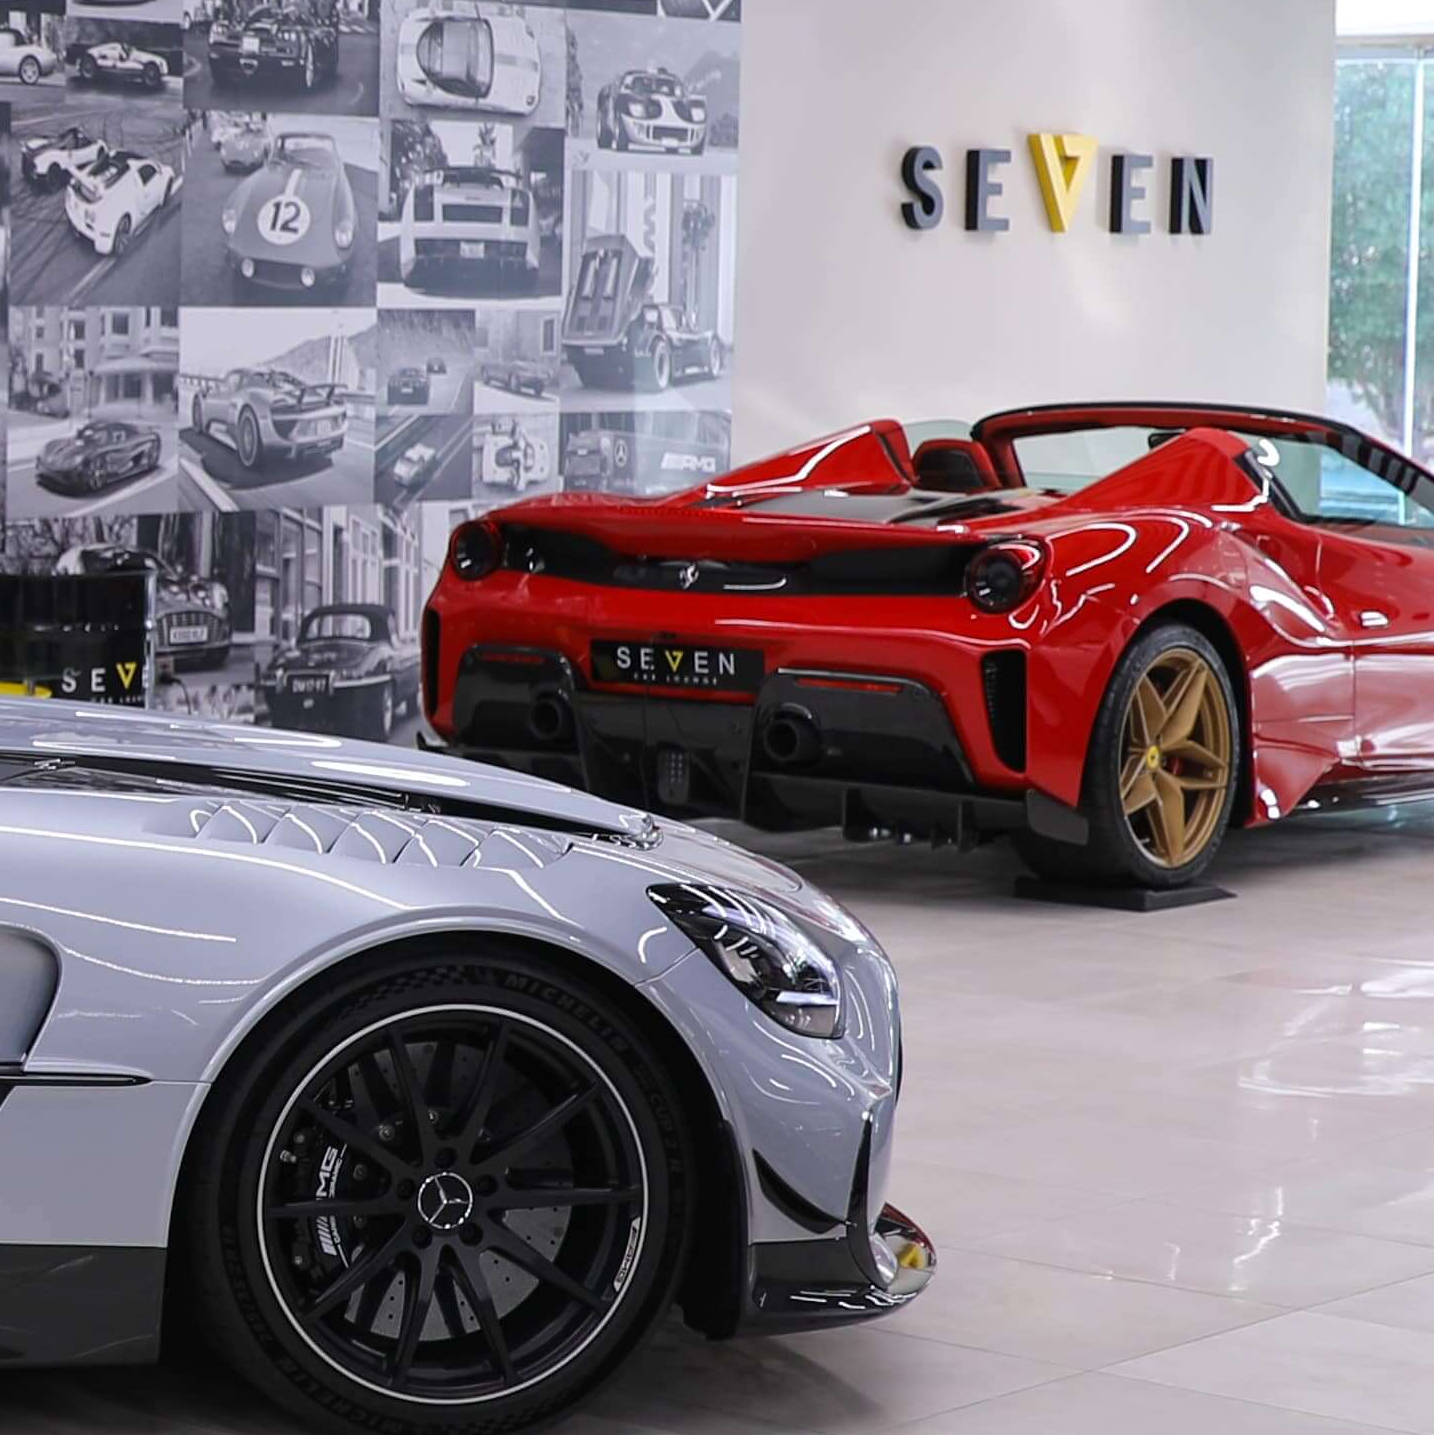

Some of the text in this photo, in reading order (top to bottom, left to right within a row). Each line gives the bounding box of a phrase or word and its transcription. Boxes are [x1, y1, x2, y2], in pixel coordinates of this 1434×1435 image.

[900, 132, 1214, 235] SEVEN
[270, 200, 301, 234] 12
[616, 646, 735, 676] SEVEN
